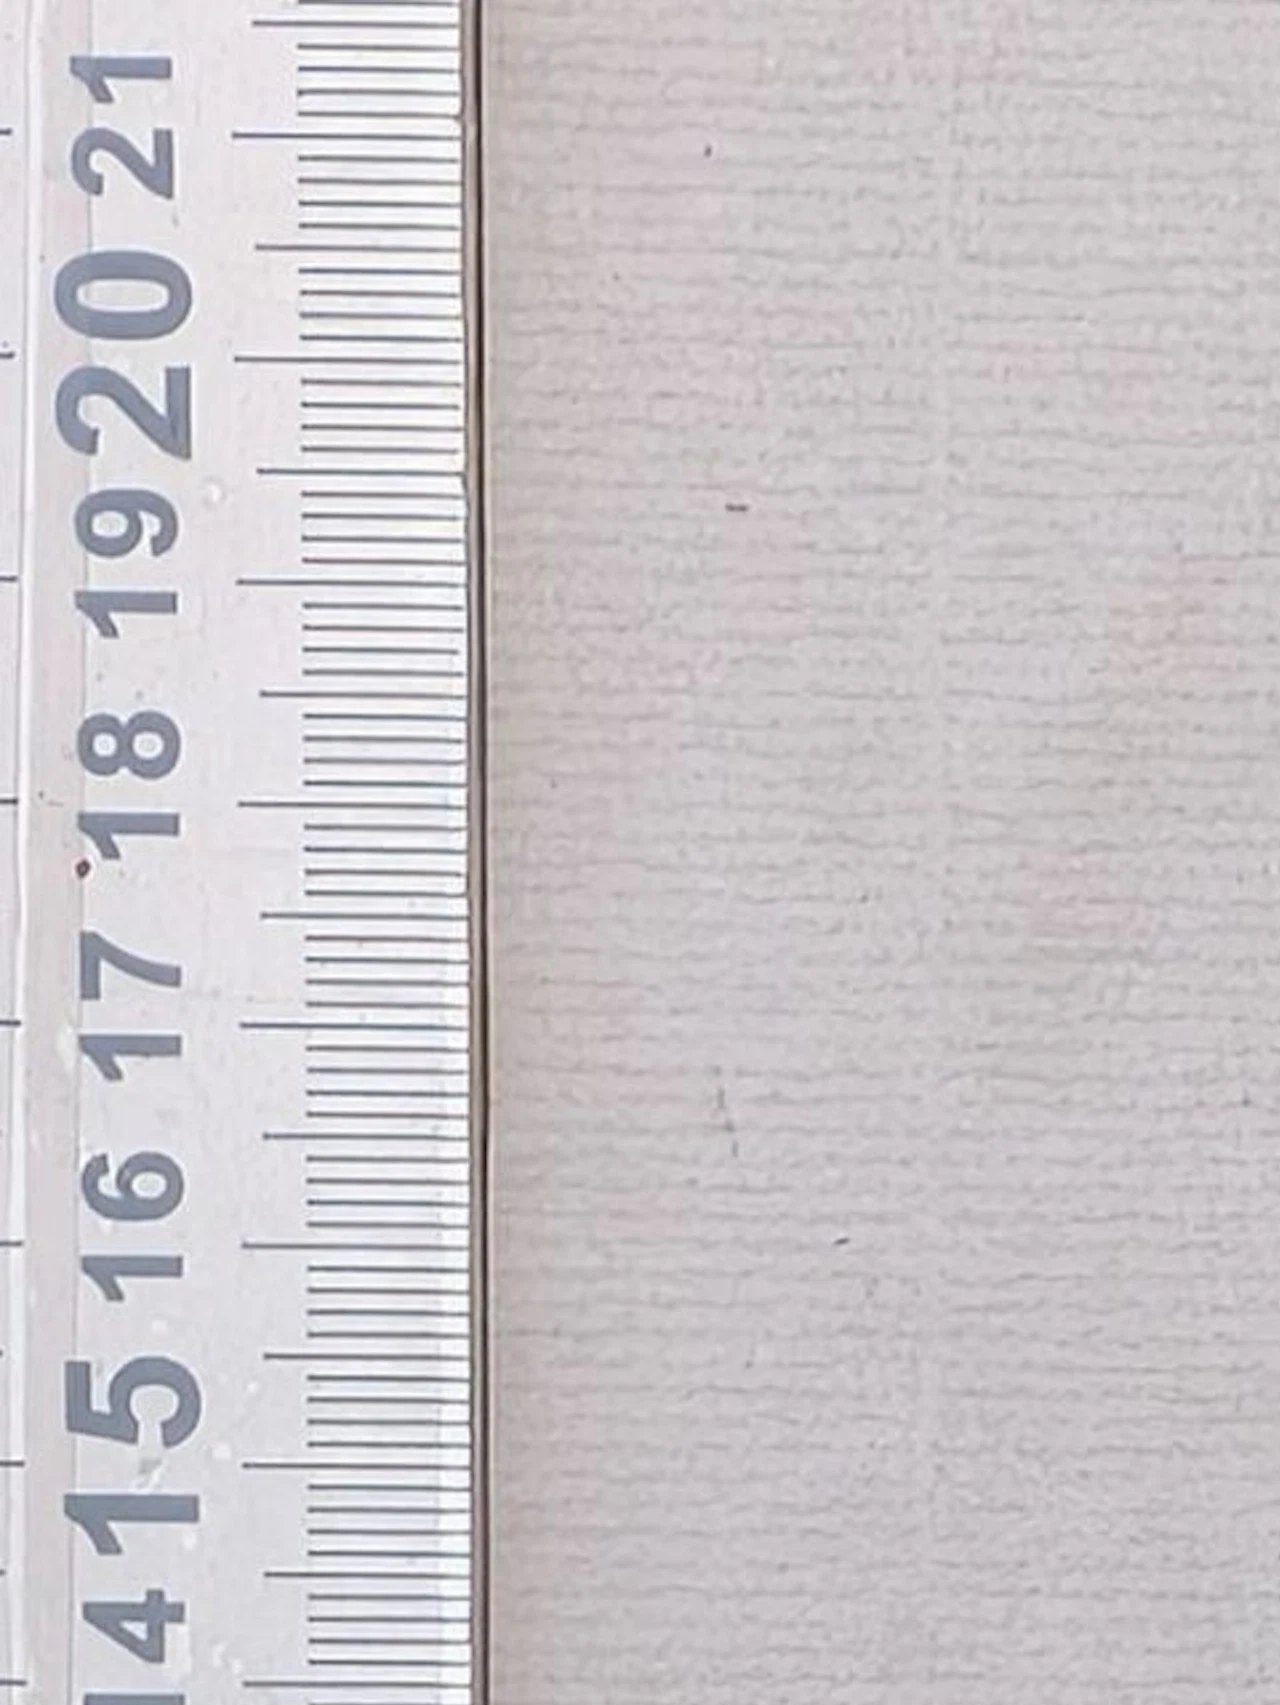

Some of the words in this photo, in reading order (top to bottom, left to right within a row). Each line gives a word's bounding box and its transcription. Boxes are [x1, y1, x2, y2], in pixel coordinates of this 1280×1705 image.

[69, 55, 174, 200] 21
[54, 249, 192, 461] 20
[74, 487, 178, 639] 19
[77, 710, 181, 860] 18
[78, 931, 182, 1081] 17
[81, 1152, 184, 1302] 16
[64, 1356, 203, 1555] 15
